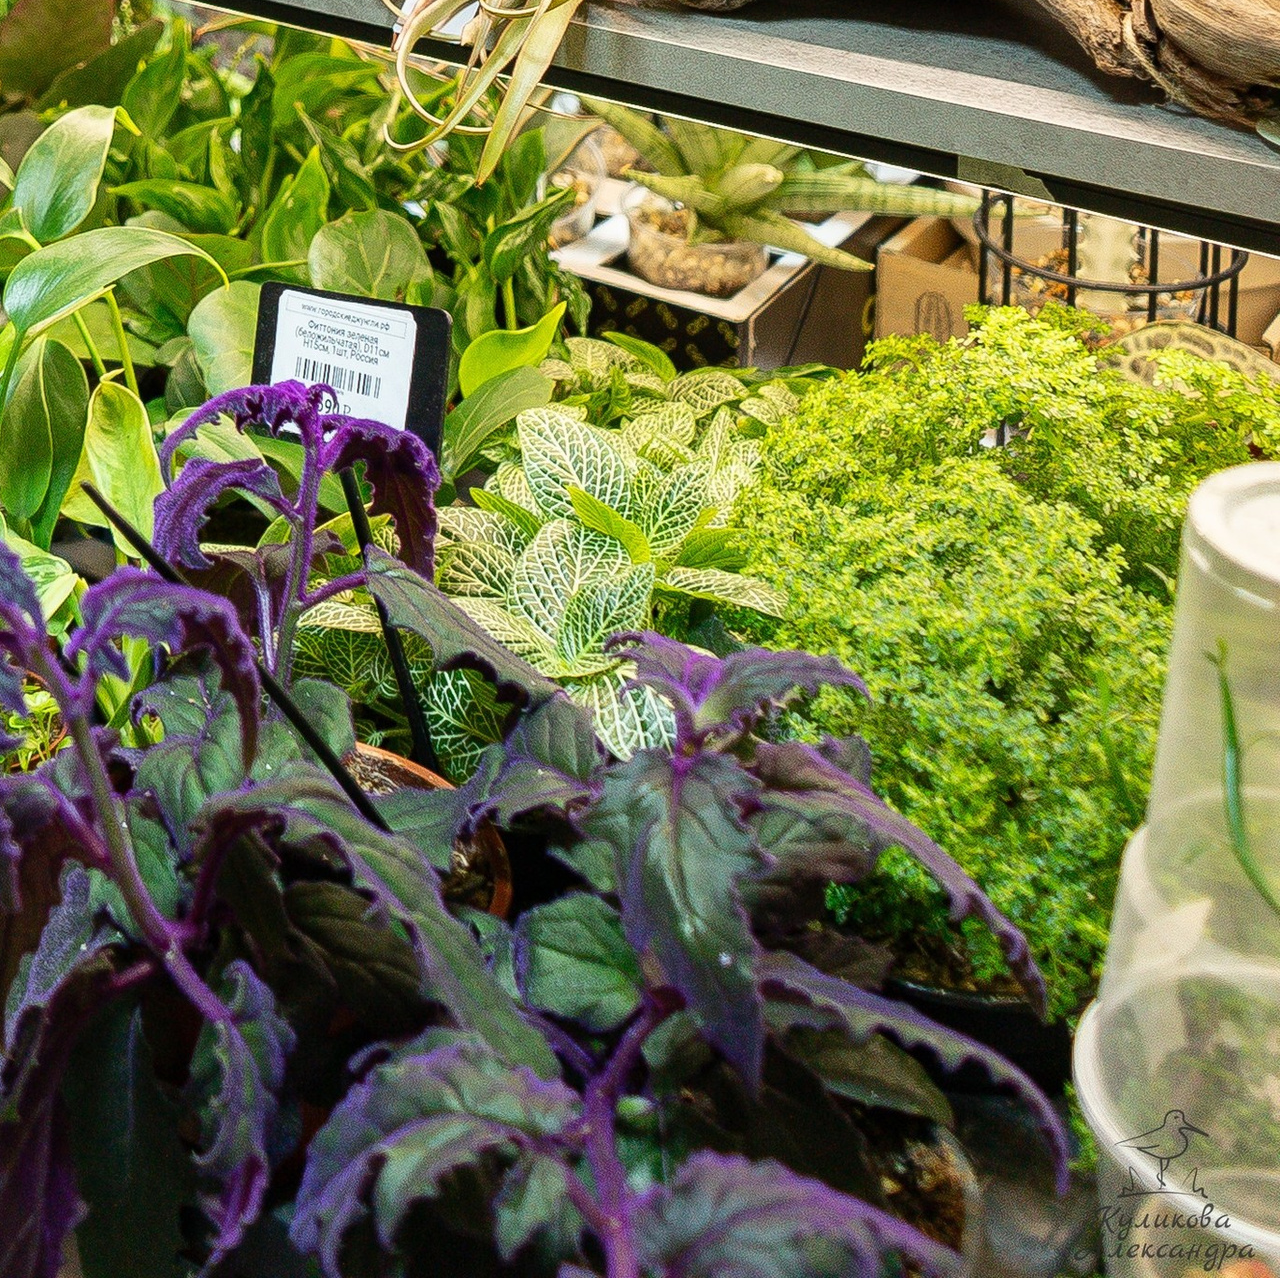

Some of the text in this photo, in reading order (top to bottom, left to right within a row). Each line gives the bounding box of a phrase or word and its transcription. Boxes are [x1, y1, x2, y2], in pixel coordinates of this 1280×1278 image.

[308, 319, 379, 345] Фиттония зеленая
[350, 349, 379, 365] Россия
